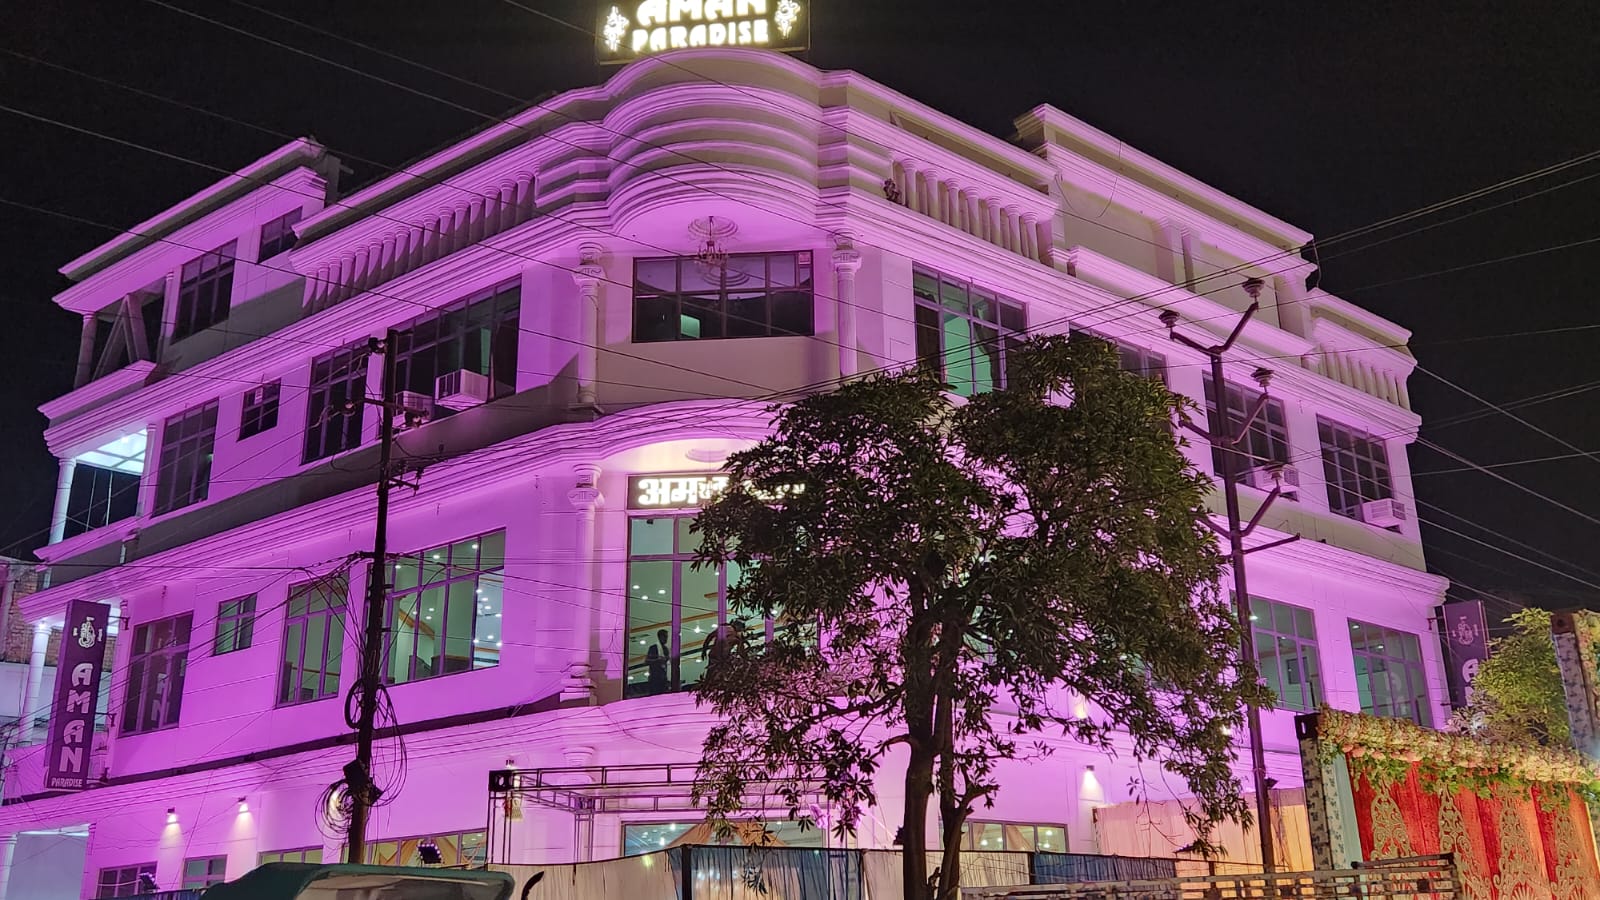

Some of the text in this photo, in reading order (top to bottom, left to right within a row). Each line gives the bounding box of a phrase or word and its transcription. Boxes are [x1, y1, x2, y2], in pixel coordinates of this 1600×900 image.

[636, 0, 767, 26] AMAN
[632, 19, 769, 52] PARADISE
[59, 663, 93, 773] AMAN
[51, 777, 83, 787] PARADISE
